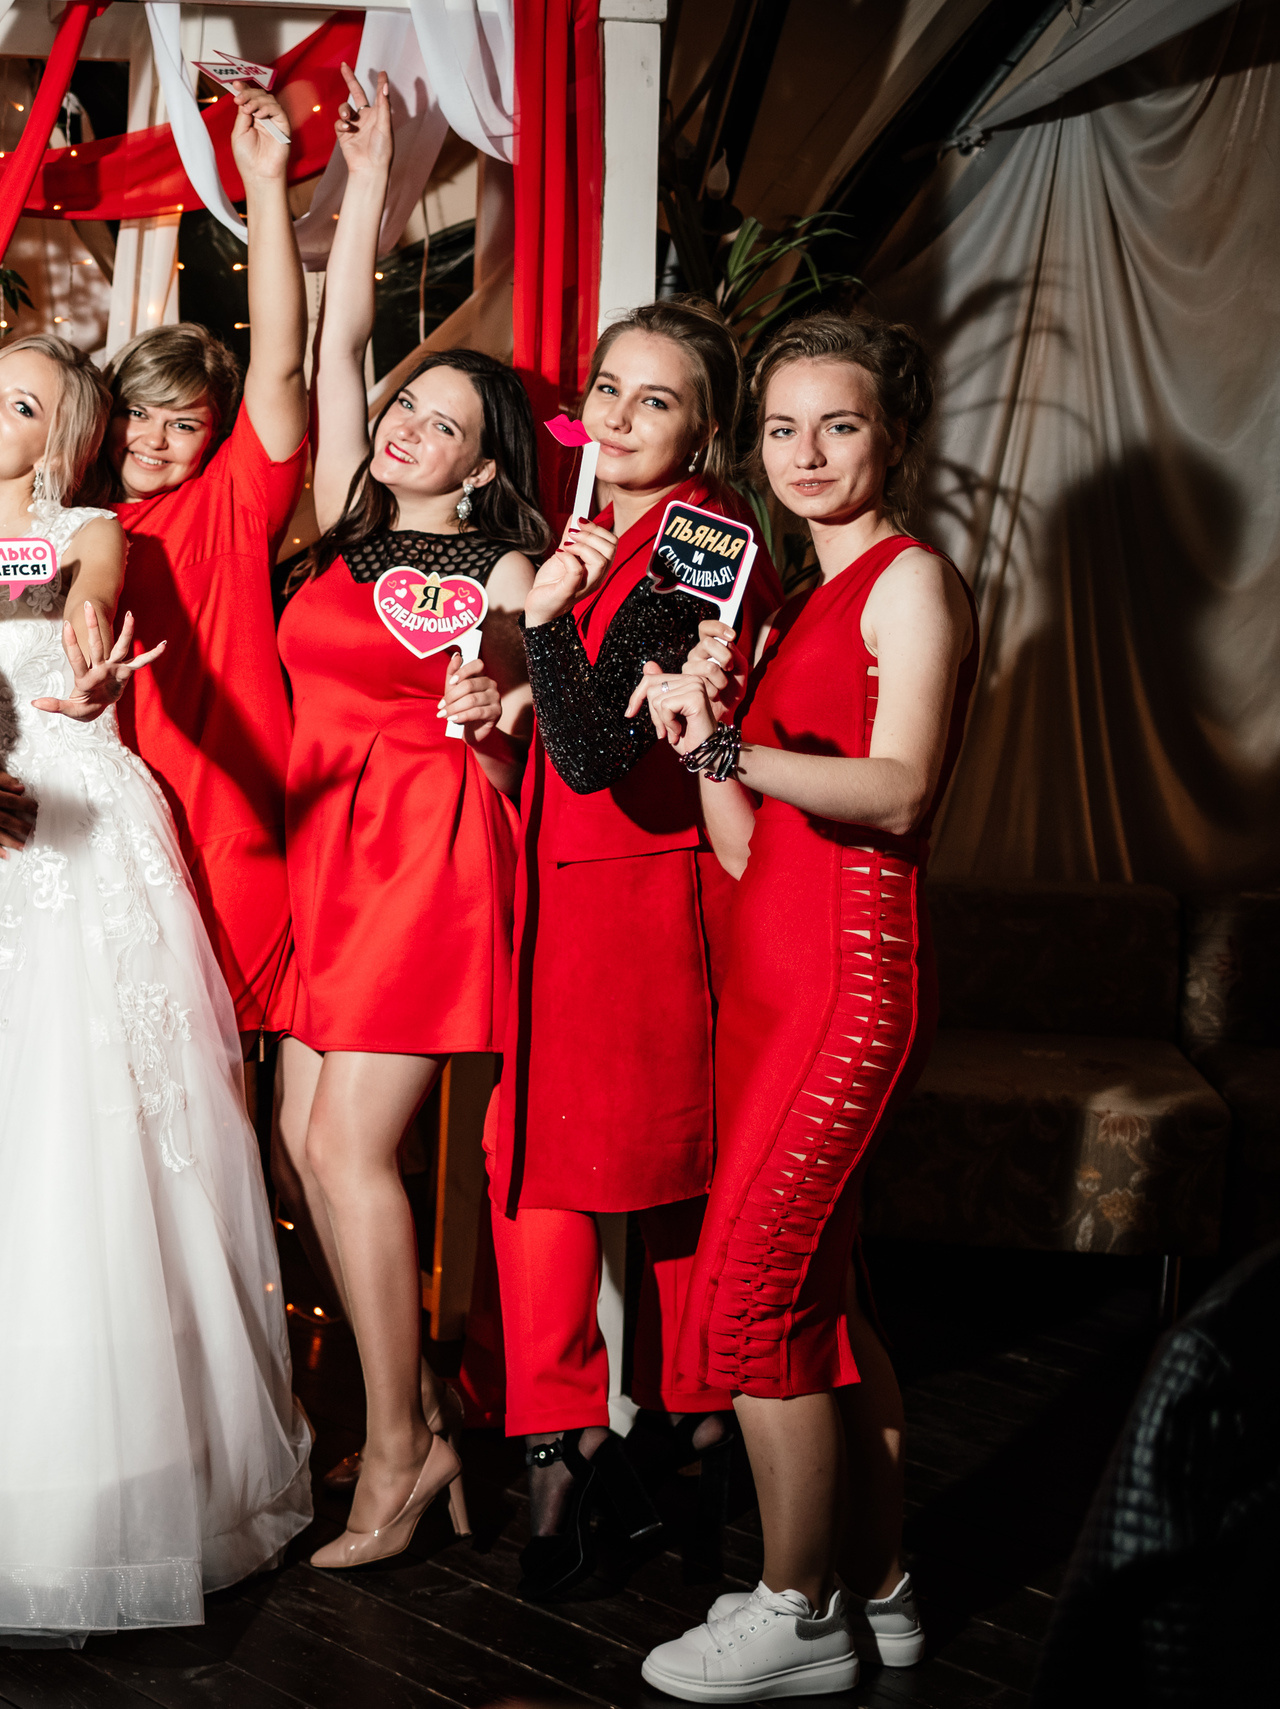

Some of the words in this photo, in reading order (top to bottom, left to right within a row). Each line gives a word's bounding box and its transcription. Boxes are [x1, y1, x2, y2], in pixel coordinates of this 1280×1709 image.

[664, 515, 746, 560] ПЬЯНАЯ
[657, 545, 736, 588] СЧАСТЛИВАЯ!
[380, 597, 479, 634] СЛЕДУЮЩАЯ!
[417, 585, 441, 611] Я
